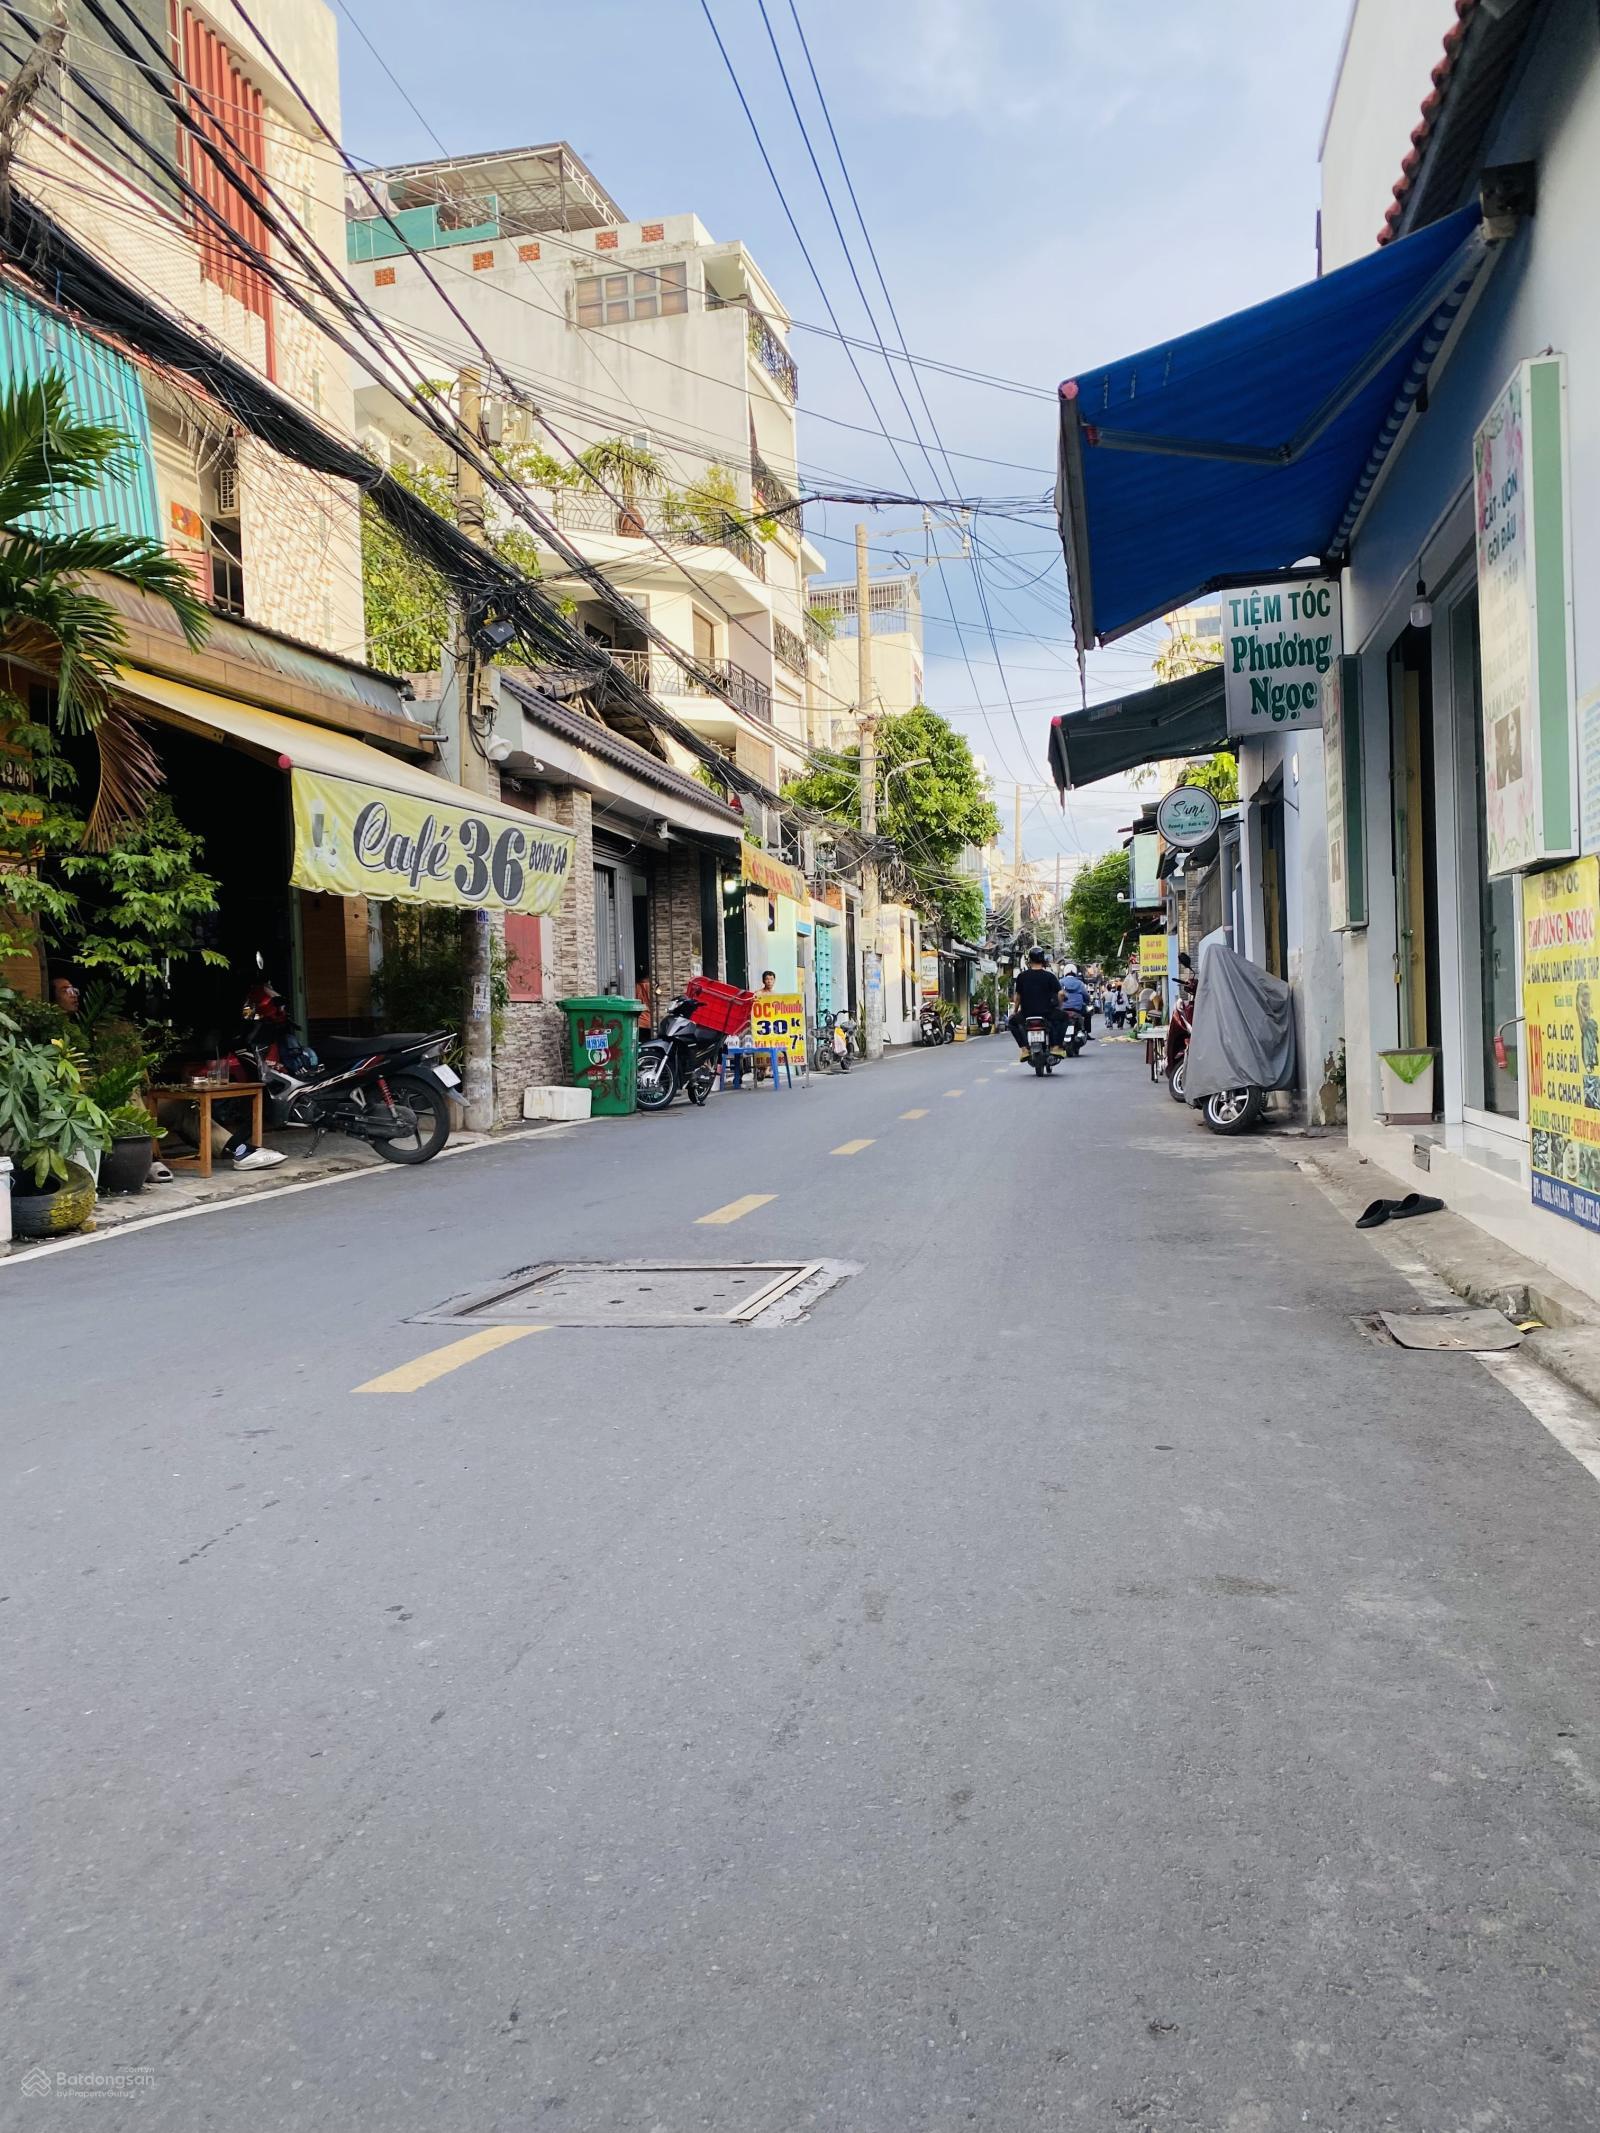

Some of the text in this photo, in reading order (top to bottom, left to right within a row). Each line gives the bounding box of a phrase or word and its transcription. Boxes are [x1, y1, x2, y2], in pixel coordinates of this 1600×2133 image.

[1228, 582, 1331, 631] TIỆM TÓC
[1231, 632, 1333, 674] Phương
[1249, 676, 1318, 722] Ngọc
[353, 801, 454, 891] Café
[454, 818, 528, 906] 36
